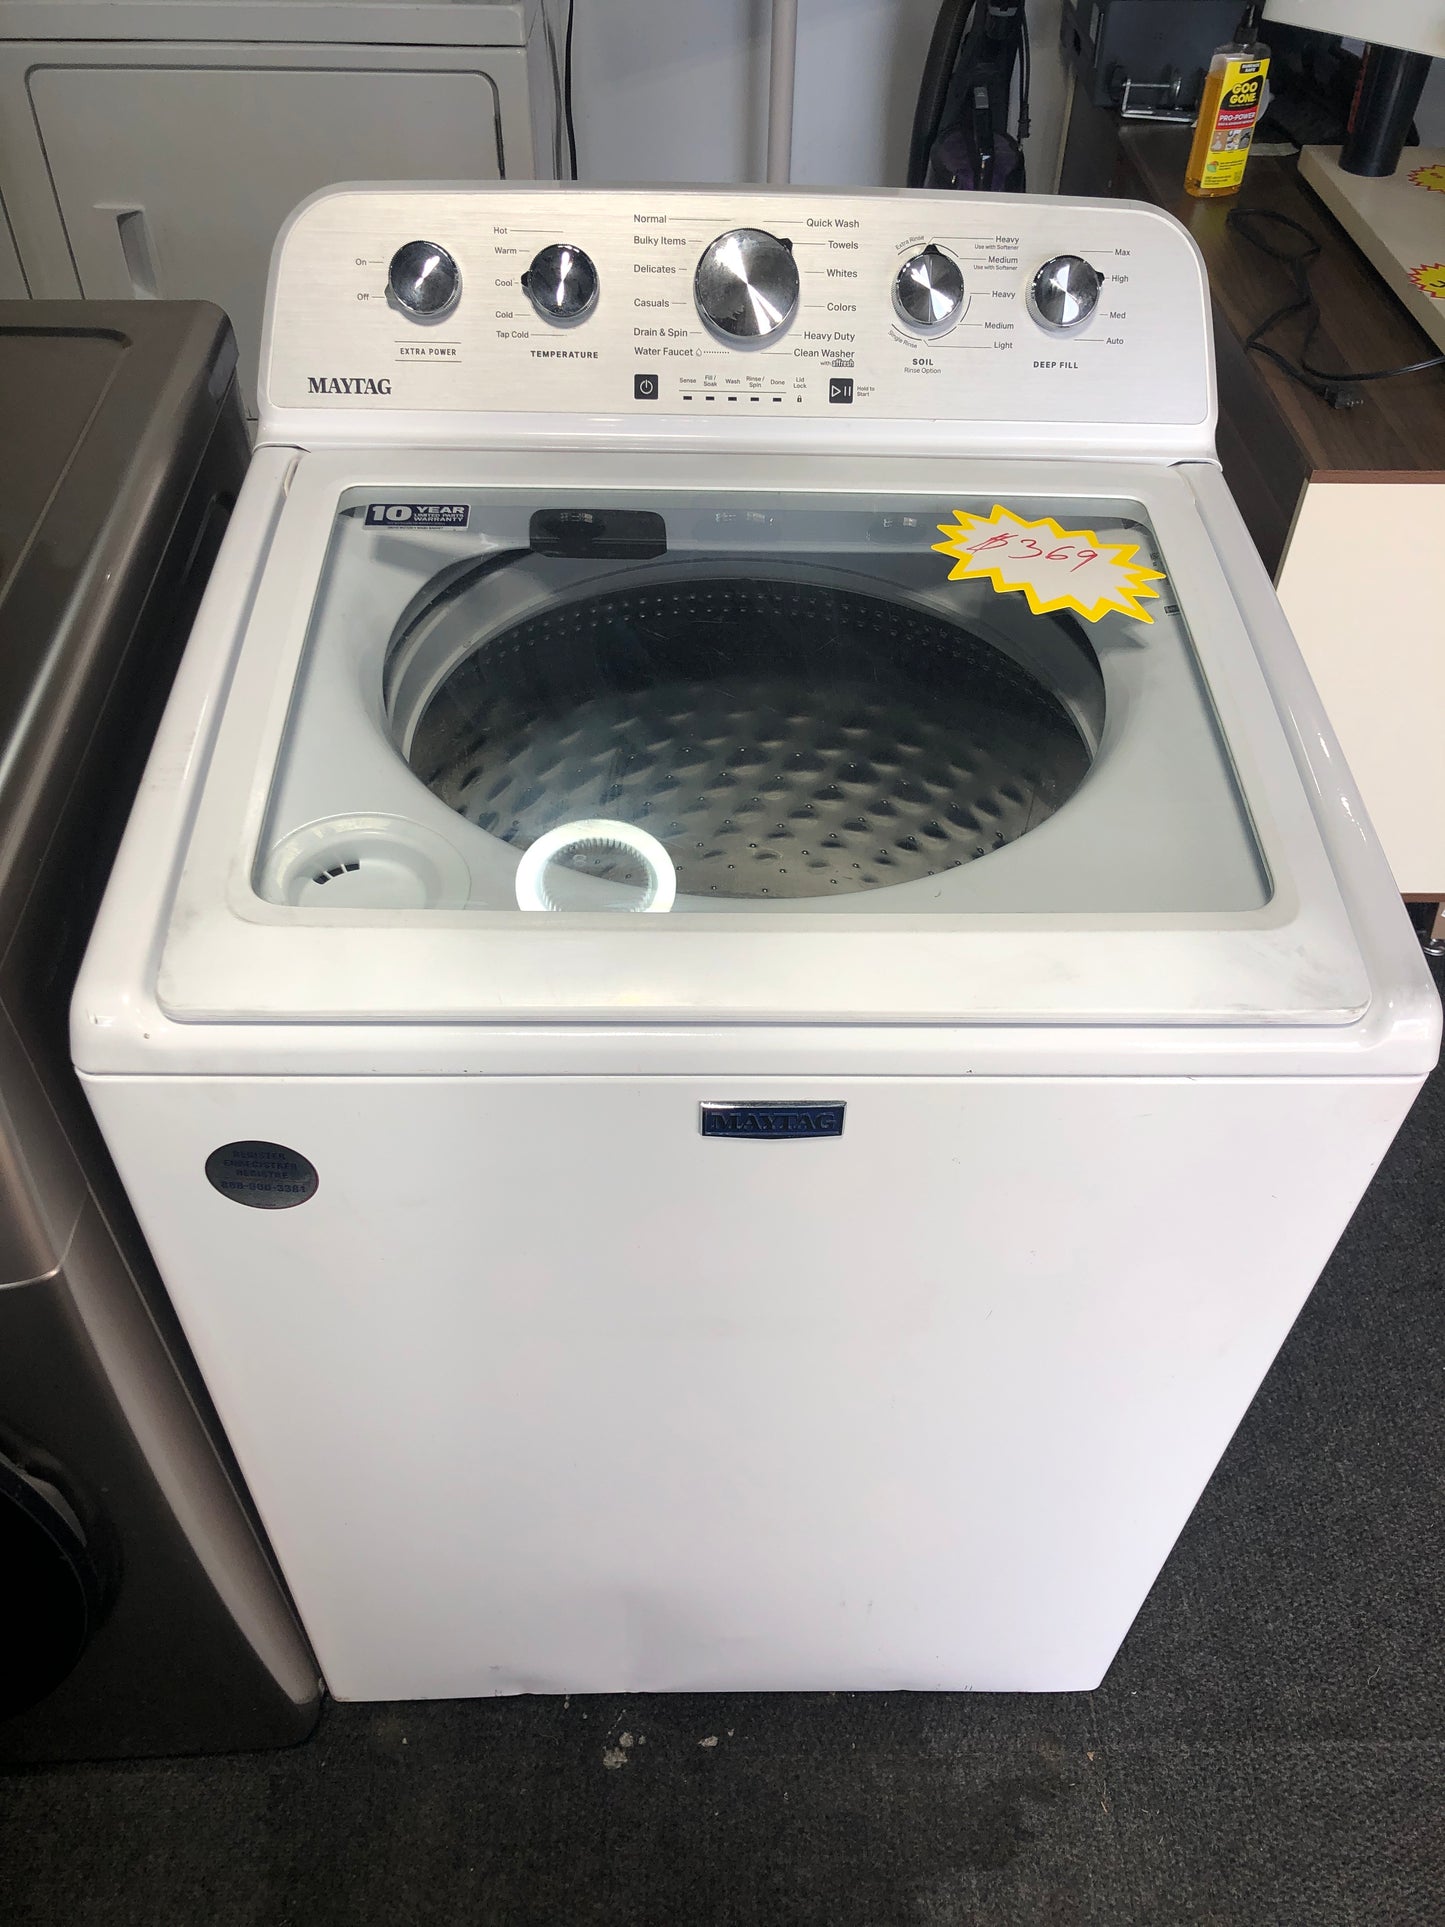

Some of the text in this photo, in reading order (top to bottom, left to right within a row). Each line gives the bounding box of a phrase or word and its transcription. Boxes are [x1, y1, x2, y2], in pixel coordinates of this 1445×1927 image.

[1232, 82, 1258, 94] GOO
[1229, 93, 1257, 104] GONE
[633, 214, 667, 224] Normal
[806, 218, 860, 228] Quick Wash
[493, 227, 508, 235] Hot
[634, 236, 687, 246] Bulky Items
[895, 235, 925, 250] Extra Rinse
[995, 235, 1020, 244] Heavy
[828, 240, 859, 250] Towels
[494, 247, 518, 255] Warm
[1114, 248, 1131, 256] Max
[355, 258, 367, 266] On
[988, 256, 1018, 264] Medium
[633, 265, 676, 274] Delicates
[826, 269, 858, 278] Whites
[494, 279, 514, 288] Cool
[1111, 274, 1129, 284] High
[357, 293, 370, 301] Off
[992, 290, 1016, 299] Heavy
[634, 298, 670, 308] Casuals
[827, 302, 857, 312] Colors
[495, 311, 514, 319] Cold
[984, 322, 1014, 330] Medium
[496, 331, 529, 340] Tap Cold
[633, 328, 688, 339] Drain & Spin
[804, 331, 855, 343] Heavy Duty
[888, 330, 918, 349] Single Rinse
[1106, 337, 1124, 345] Auto
[994, 342, 1013, 350] Light
[400, 347, 457, 356] EXTRA POWER
[531, 350, 599, 359] TEMPERATURE
[634, 347, 694, 357] Water Faucet
[793, 348, 855, 358] Clean Washer
[912, 358, 934, 366] SOIL
[1033, 361, 1079, 369] DEEP FILL
[921, 367, 942, 375] Option
[307, 377, 392, 395] MAYTAG
[372, 505, 412, 522] 10
[416, 506, 465, 514] YEAR
[710, 1111, 838, 1130] MAYTAG
